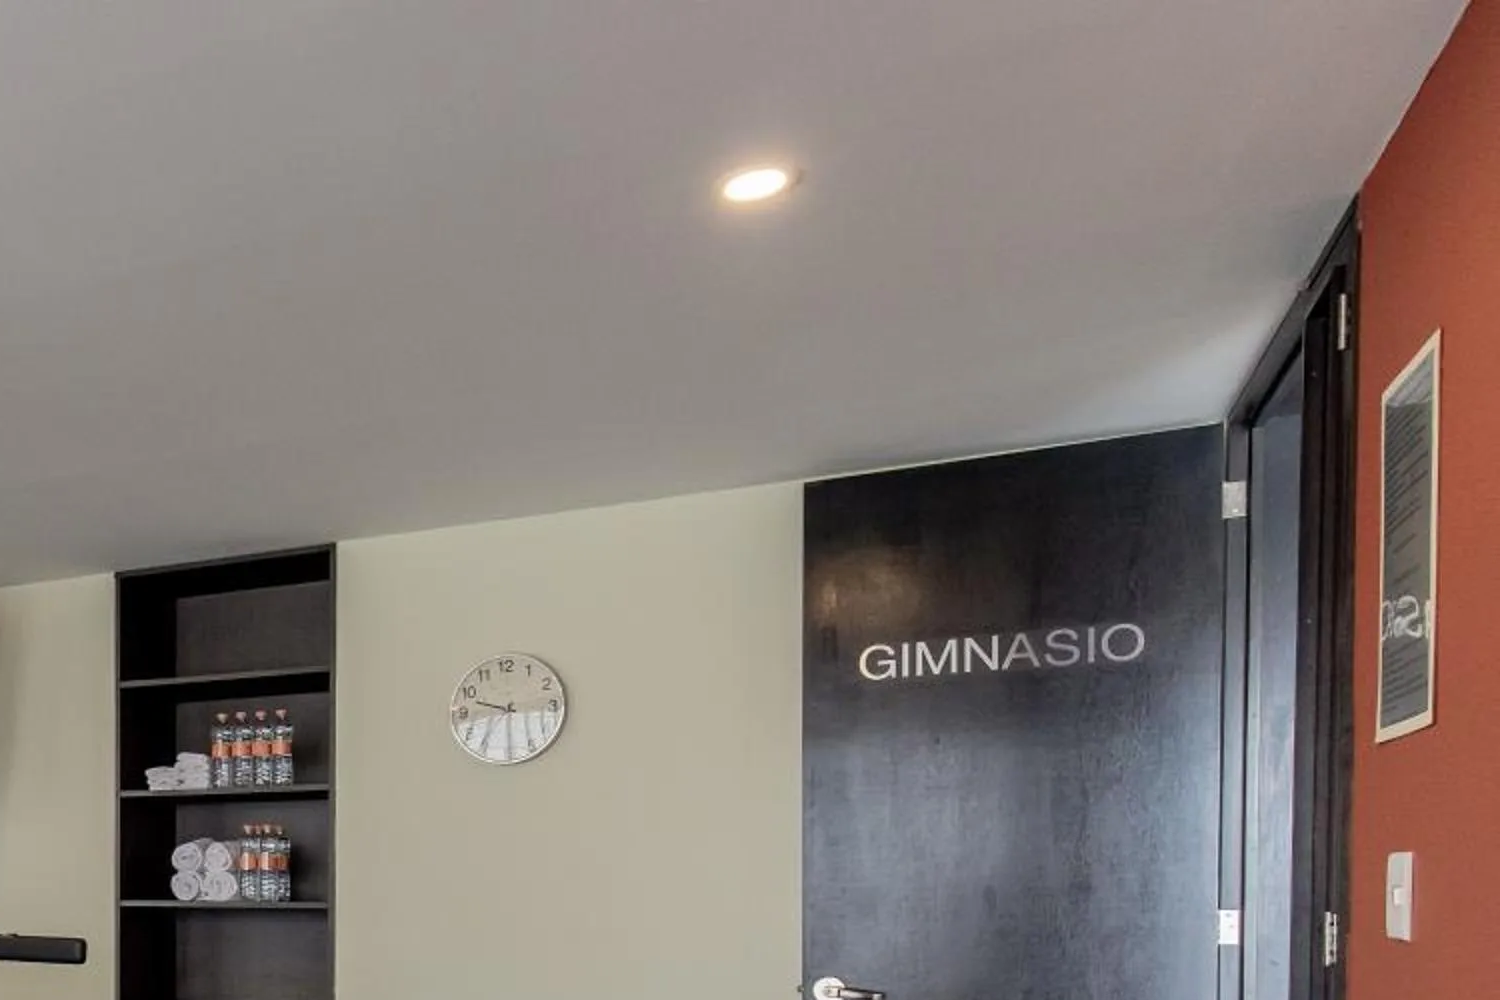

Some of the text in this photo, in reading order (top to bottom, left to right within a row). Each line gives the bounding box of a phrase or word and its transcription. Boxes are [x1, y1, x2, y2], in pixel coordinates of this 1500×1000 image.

[858, 623, 1146, 681] GIMNASIO
[498, 659, 515, 673] 12
[525, 663, 532, 677] 1
[478, 669, 491, 683] 11
[541, 676, 552, 691] 2
[462, 684, 477, 700] 10
